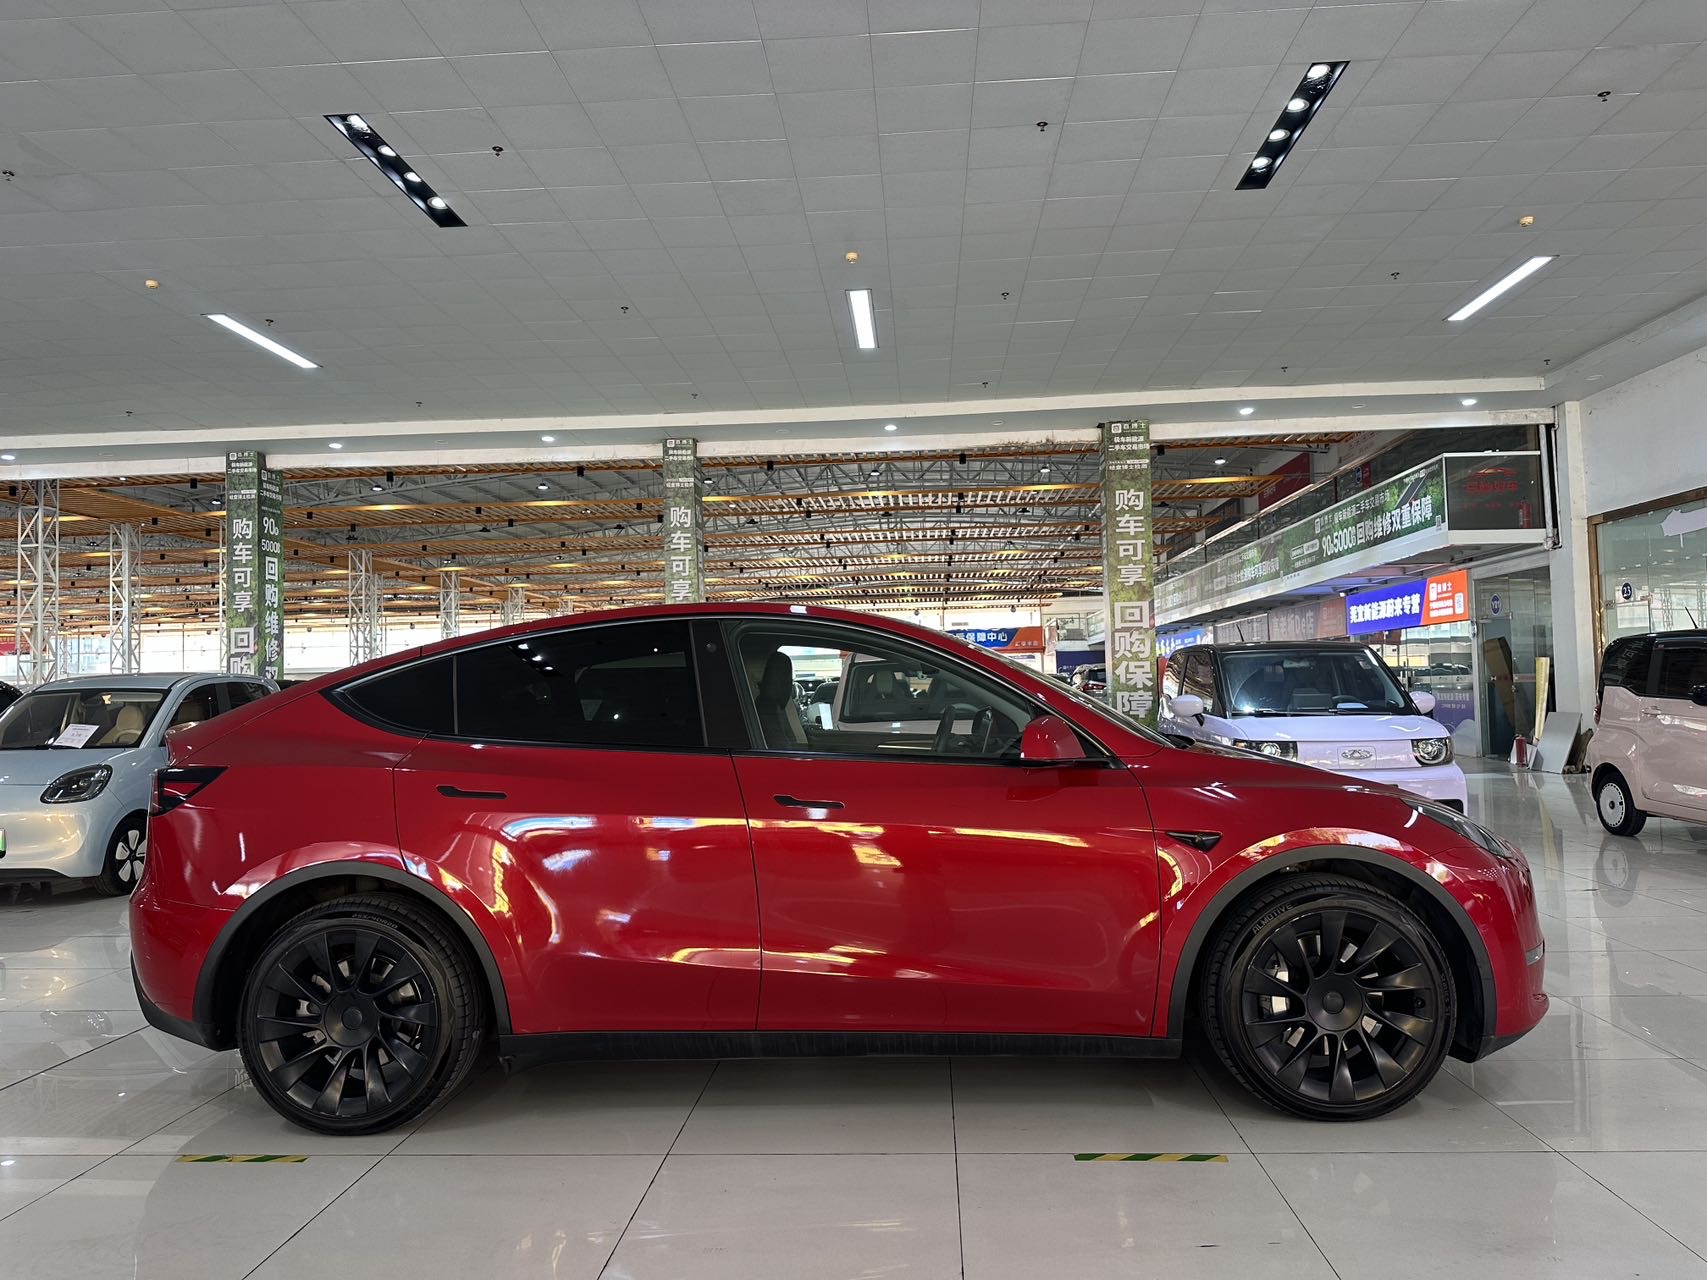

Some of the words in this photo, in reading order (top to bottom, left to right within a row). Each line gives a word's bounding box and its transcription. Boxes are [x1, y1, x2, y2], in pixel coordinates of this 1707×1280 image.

[232, 518, 253, 612] 购车可享
[670, 507, 693, 600] 购车可享
[1115, 489, 1147, 586] 购车可享
[1114, 600, 1153, 719] 回购保障
